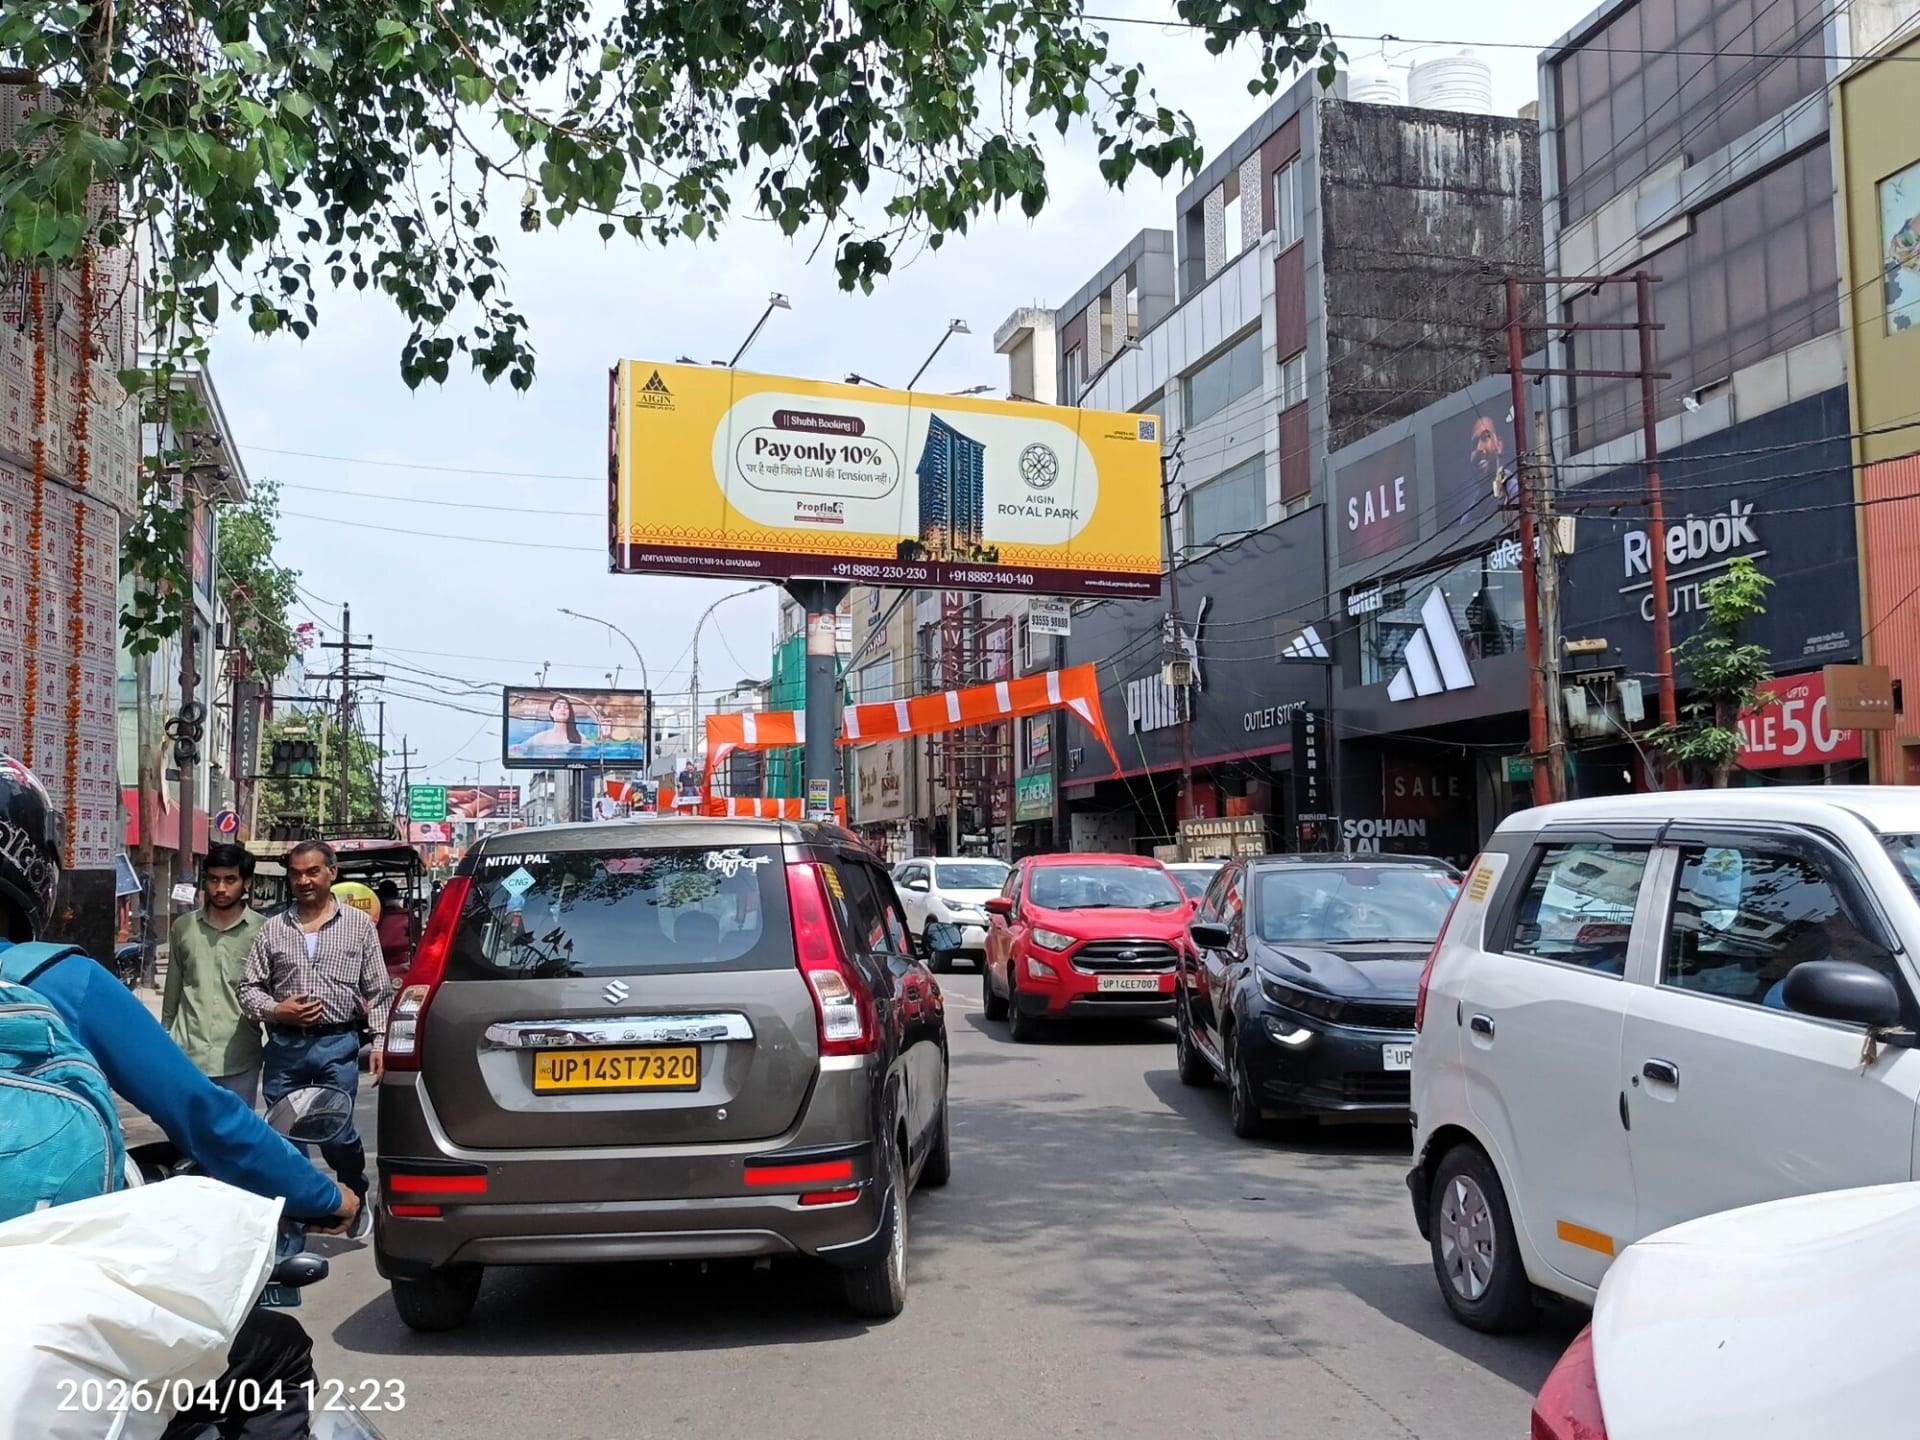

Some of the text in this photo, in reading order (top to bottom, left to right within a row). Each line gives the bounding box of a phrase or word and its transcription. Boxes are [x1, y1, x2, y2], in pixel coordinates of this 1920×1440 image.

[791, 415, 817, 428] Shubh
[818, 418, 851, 432] Booking
[755, 437, 882, 466] Pay only 10%
[804, 467, 824, 478] EMI
[837, 469, 873, 483] Tension
[1025, 495, 1055, 505] AIGIN
[1348, 476, 1406, 531] SALE
[998, 504, 1079, 520] ROYAL PARK
[852, 564, 927, 580] 8882-230-230
[968, 572, 1034, 586] 8882-140-140
[1786, 686, 1809, 699] UPTO
[1243, 706, 1276, 732] OUTLET
[241, 699, 251, 777] CARATLANE
[1393, 775, 1460, 797] SALE
[1185, 822, 1232, 843] SOHAN
[1343, 818, 1426, 838] SOHAN
[485, 853, 550, 868] NITIN PAL
[508, 877, 529, 887] CNG
